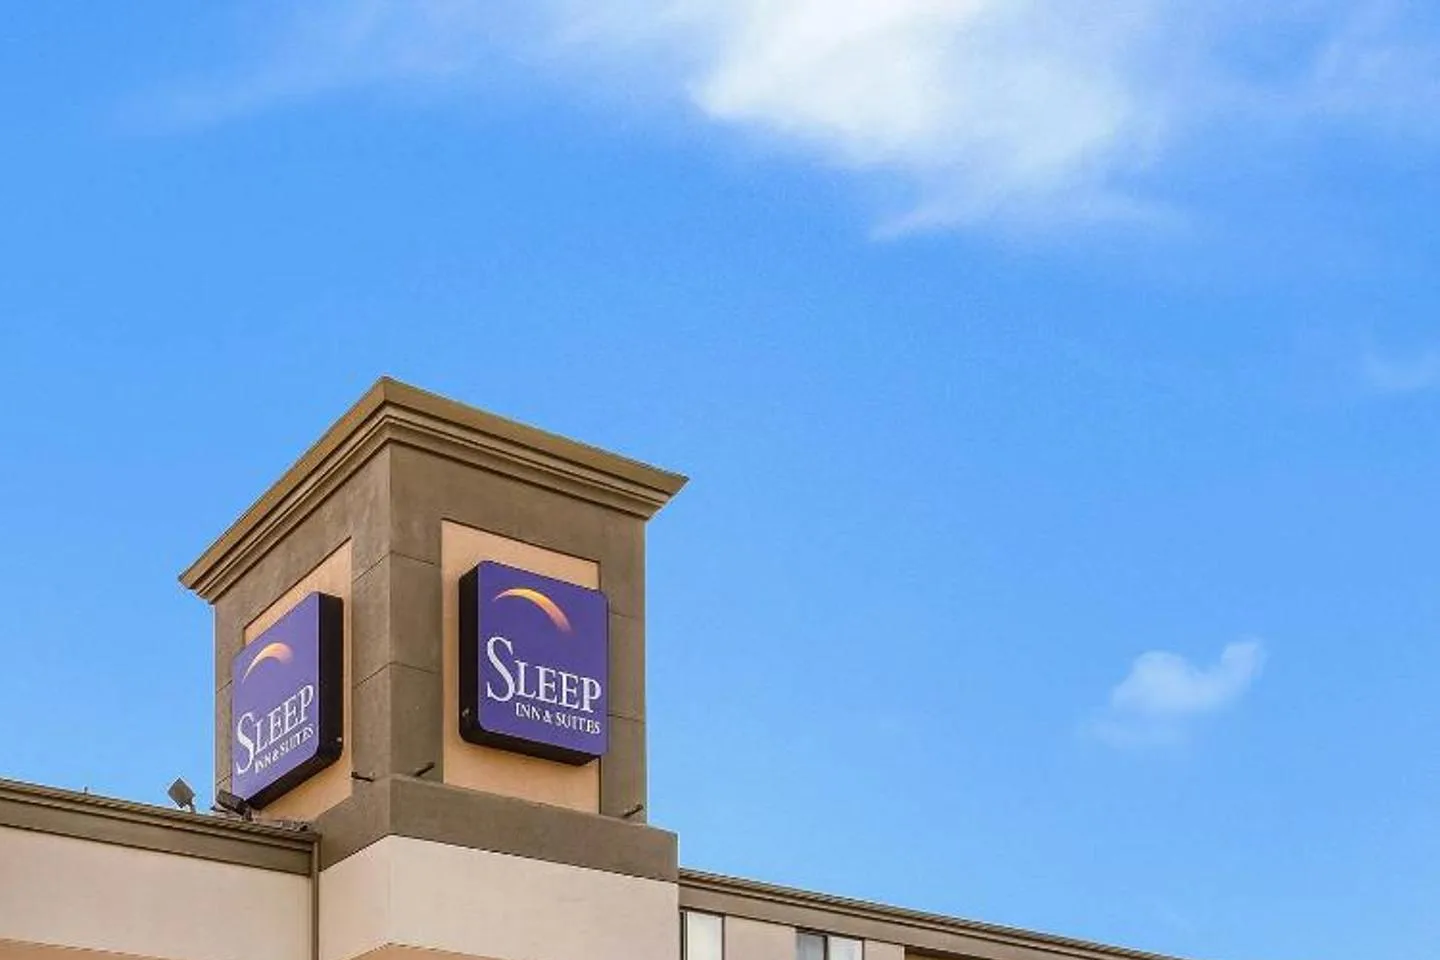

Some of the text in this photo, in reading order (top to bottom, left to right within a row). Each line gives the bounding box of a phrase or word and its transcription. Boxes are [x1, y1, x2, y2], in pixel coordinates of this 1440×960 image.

[486, 636, 602, 713] SLEEP
[236, 685, 314, 774] SLEEP
[279, 723, 314, 756] SUITES
[515, 702, 601, 734] INN & SUITES
